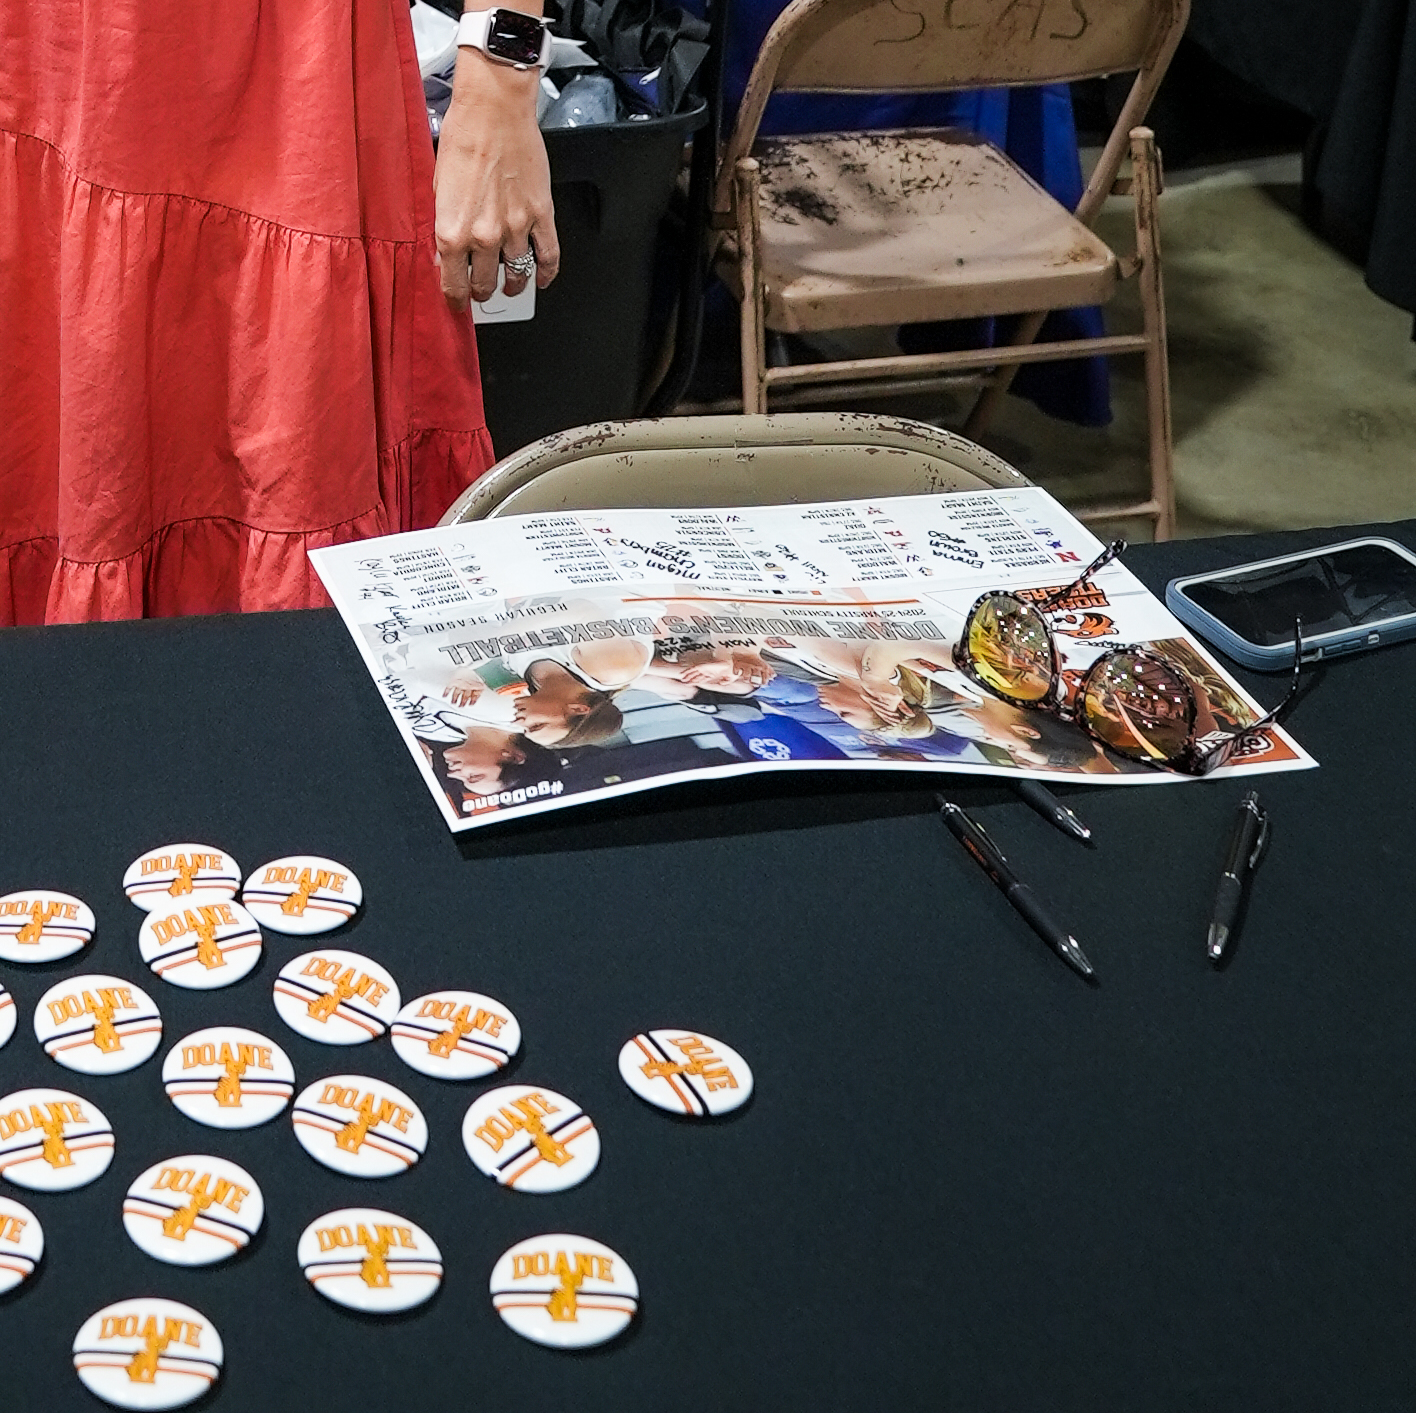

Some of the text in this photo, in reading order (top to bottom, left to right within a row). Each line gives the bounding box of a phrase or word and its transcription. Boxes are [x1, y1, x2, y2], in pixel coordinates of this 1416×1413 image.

[929, 539, 978, 557] Brown
[932, 550, 984, 569] Emma
[646, 559, 700, 580] Megan
[423, 616, 487, 634] SEASON
[494, 603, 567, 622] REGULAR
[661, 616, 830, 638] WOMEN'S
[780, 609, 832, 617] SCHEDULE
[881, 608, 925, 617] 2024-25
[438, 617, 660, 665] BASKETBALL
[826, 620, 945, 640] DOANE
[462, 780, 564, 812] #goDoane
[140, 852, 223, 876] DOANE
[261, 864, 348, 893] DOANE
[150, 903, 239, 946] DOANE
[302, 957, 390, 1007] DOANE
[46, 987, 138, 1026] DOANE
[414, 998, 507, 1038] DOANE
[181, 1042, 273, 1069] DOANE
[668, 1034, 739, 1094] DOANE
[321, 1081, 415, 1135] DOANE
[474, 1091, 560, 1152] DOANE
[152, 1166, 250, 1214] DOANE
[315, 1223, 418, 1253] DOANE
[512, 1251, 614, 1282] DOANE
[99, 1315, 203, 1348] DOANE
